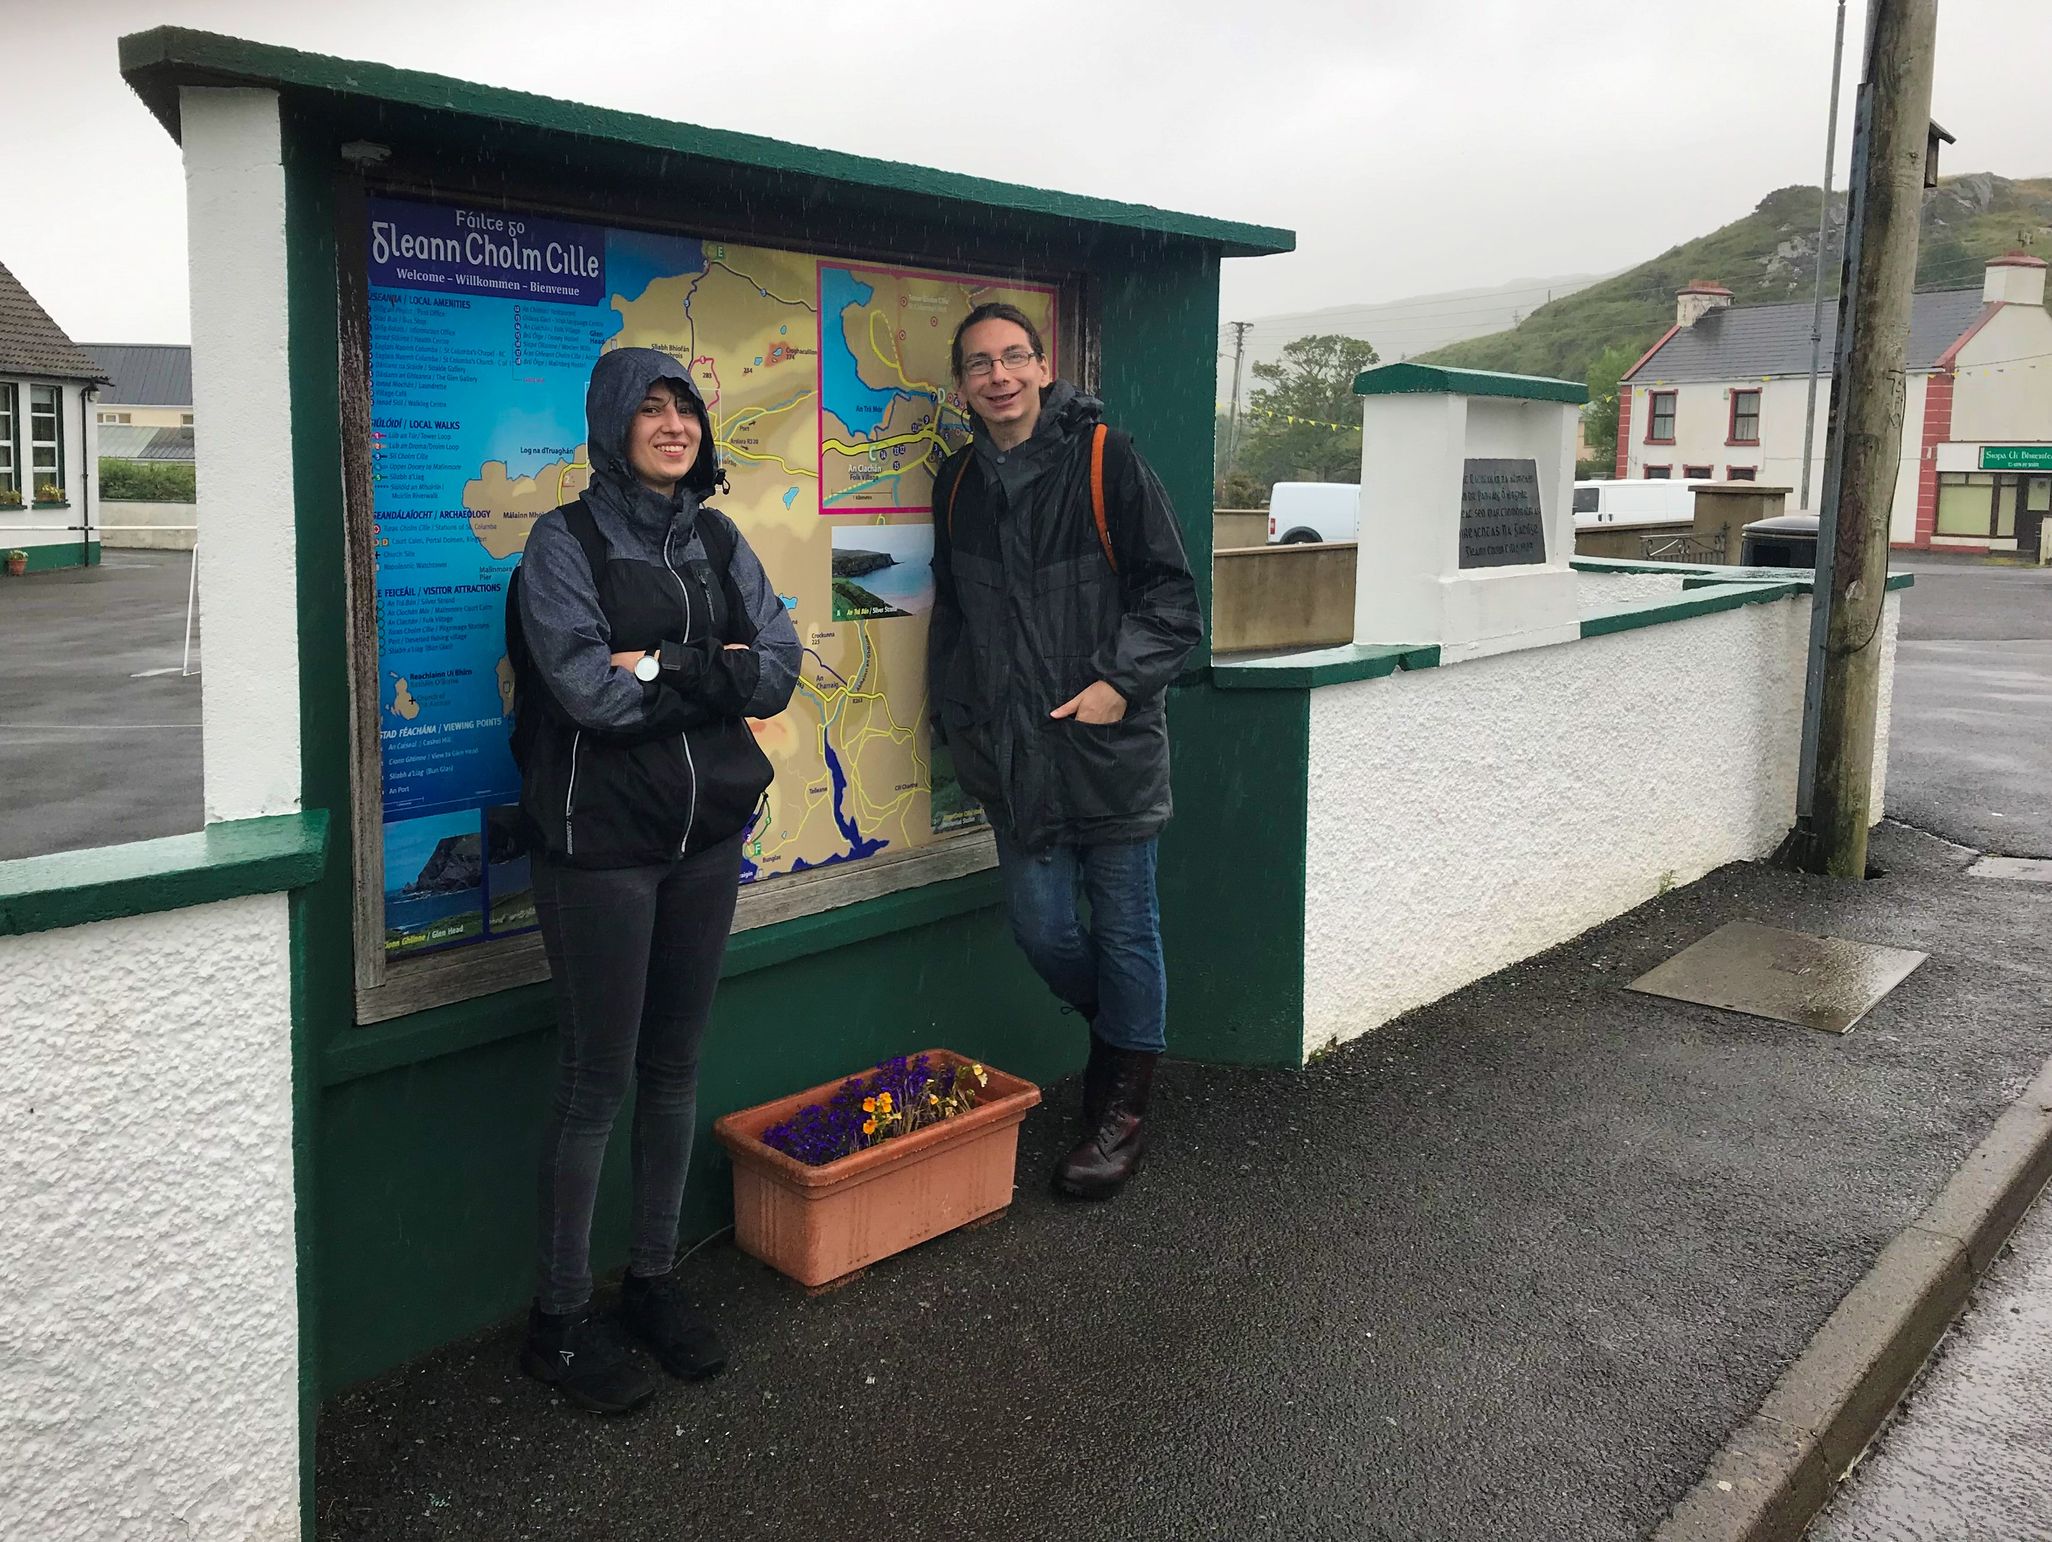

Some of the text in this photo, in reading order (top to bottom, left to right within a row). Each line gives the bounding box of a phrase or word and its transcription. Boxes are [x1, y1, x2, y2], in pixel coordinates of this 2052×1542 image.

[455, 209, 525, 237] Fáilte go
[371, 221, 599, 279] Gleann Cholm Cille
[718, 246, 724, 258] E
[396, 268, 580, 297] Welcome Willkommen Bienvenue
[410, 295, 431, 306] LOCAL
[433, 297, 470, 309] AMENITIES
[410, 420, 432, 429] LOCAL
[435, 421, 460, 430] WALKS
[520, 447, 531, 455] Log
[848, 464, 857, 472] An
[440, 510, 491, 519] ARCHAEOLOGY
[384, 586, 415, 597] FEICEÁIL
[423, 585, 452, 596] VISITOR
[454, 584, 501, 594] ATTRACTIONS
[399, 724, 436, 737] FÉACHÁNA
[443, 721, 474, 732] VIEWING
[476, 717, 502, 728] POINTS
[448, 925, 464, 936] Head
